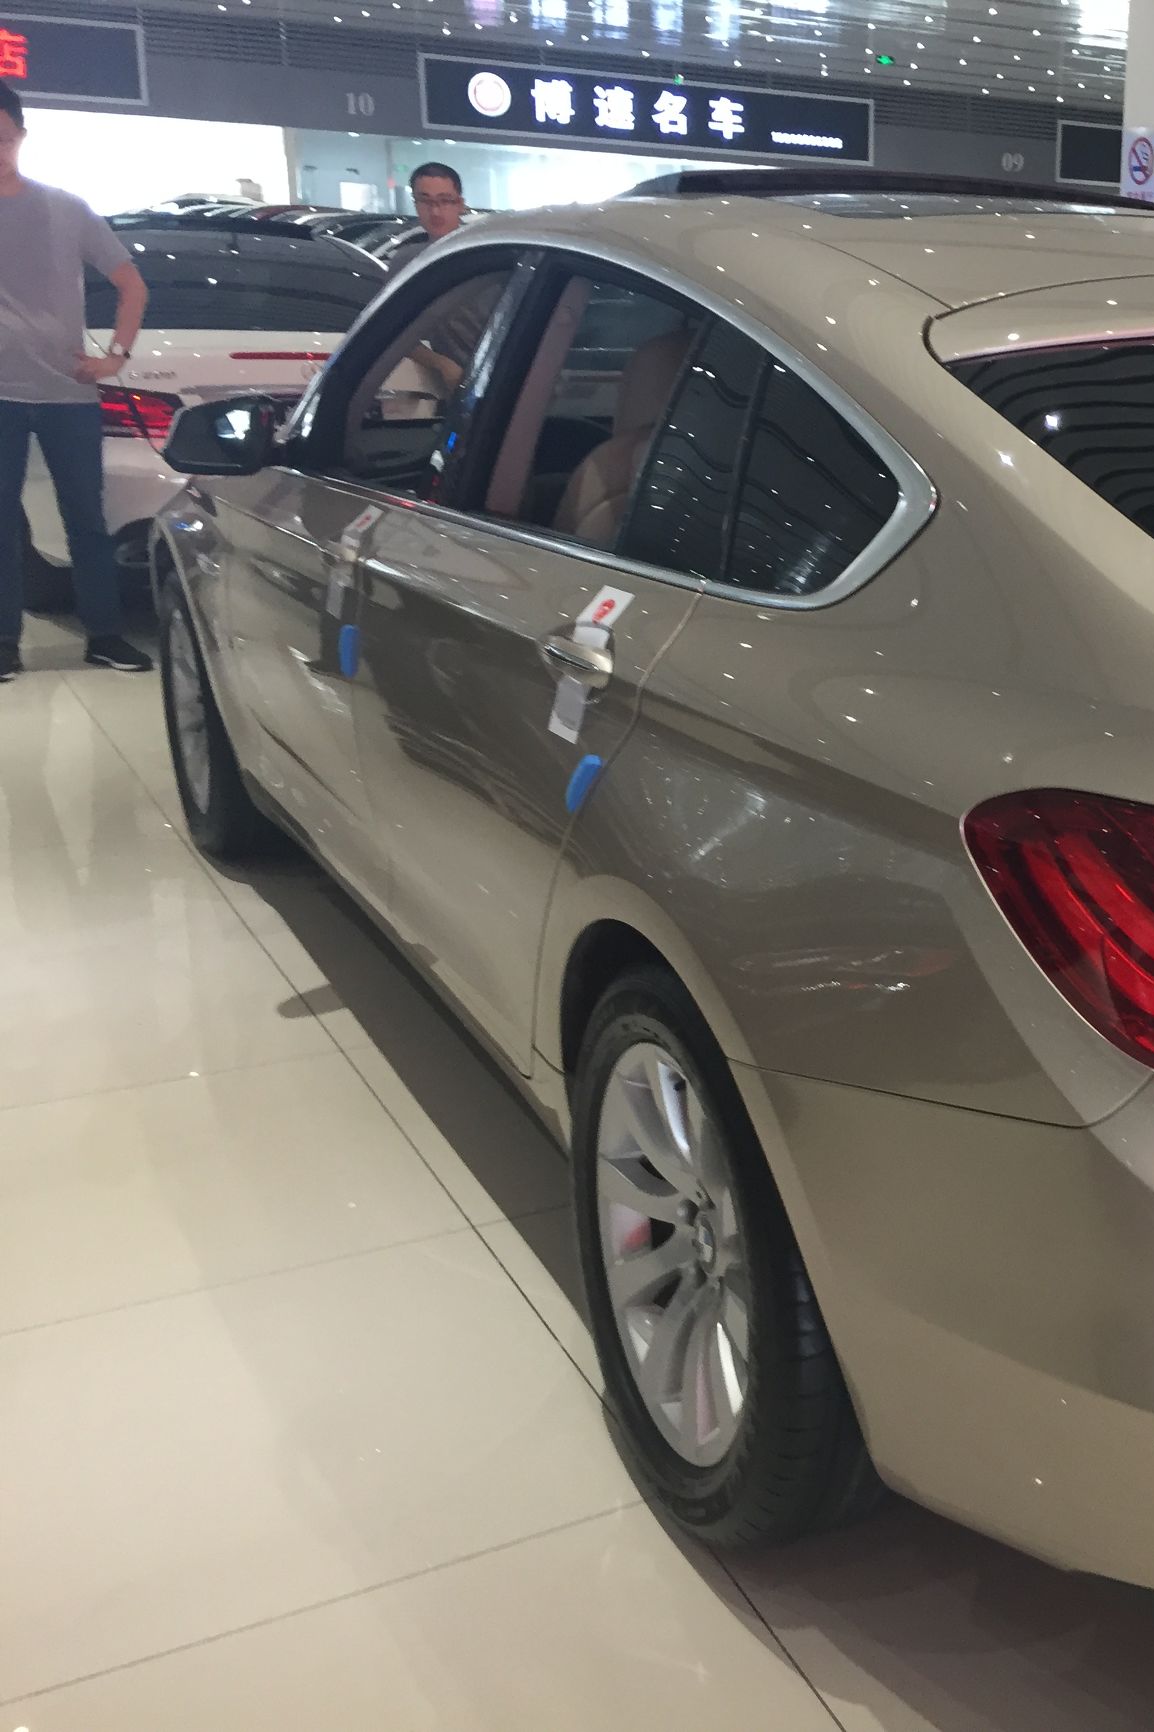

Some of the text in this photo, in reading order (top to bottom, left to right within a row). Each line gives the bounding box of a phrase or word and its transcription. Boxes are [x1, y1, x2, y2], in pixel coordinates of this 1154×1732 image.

[344, 92, 375, 116] 10
[531, 78, 745, 140] 博速名车
[1001, 152, 1025, 173] 09
